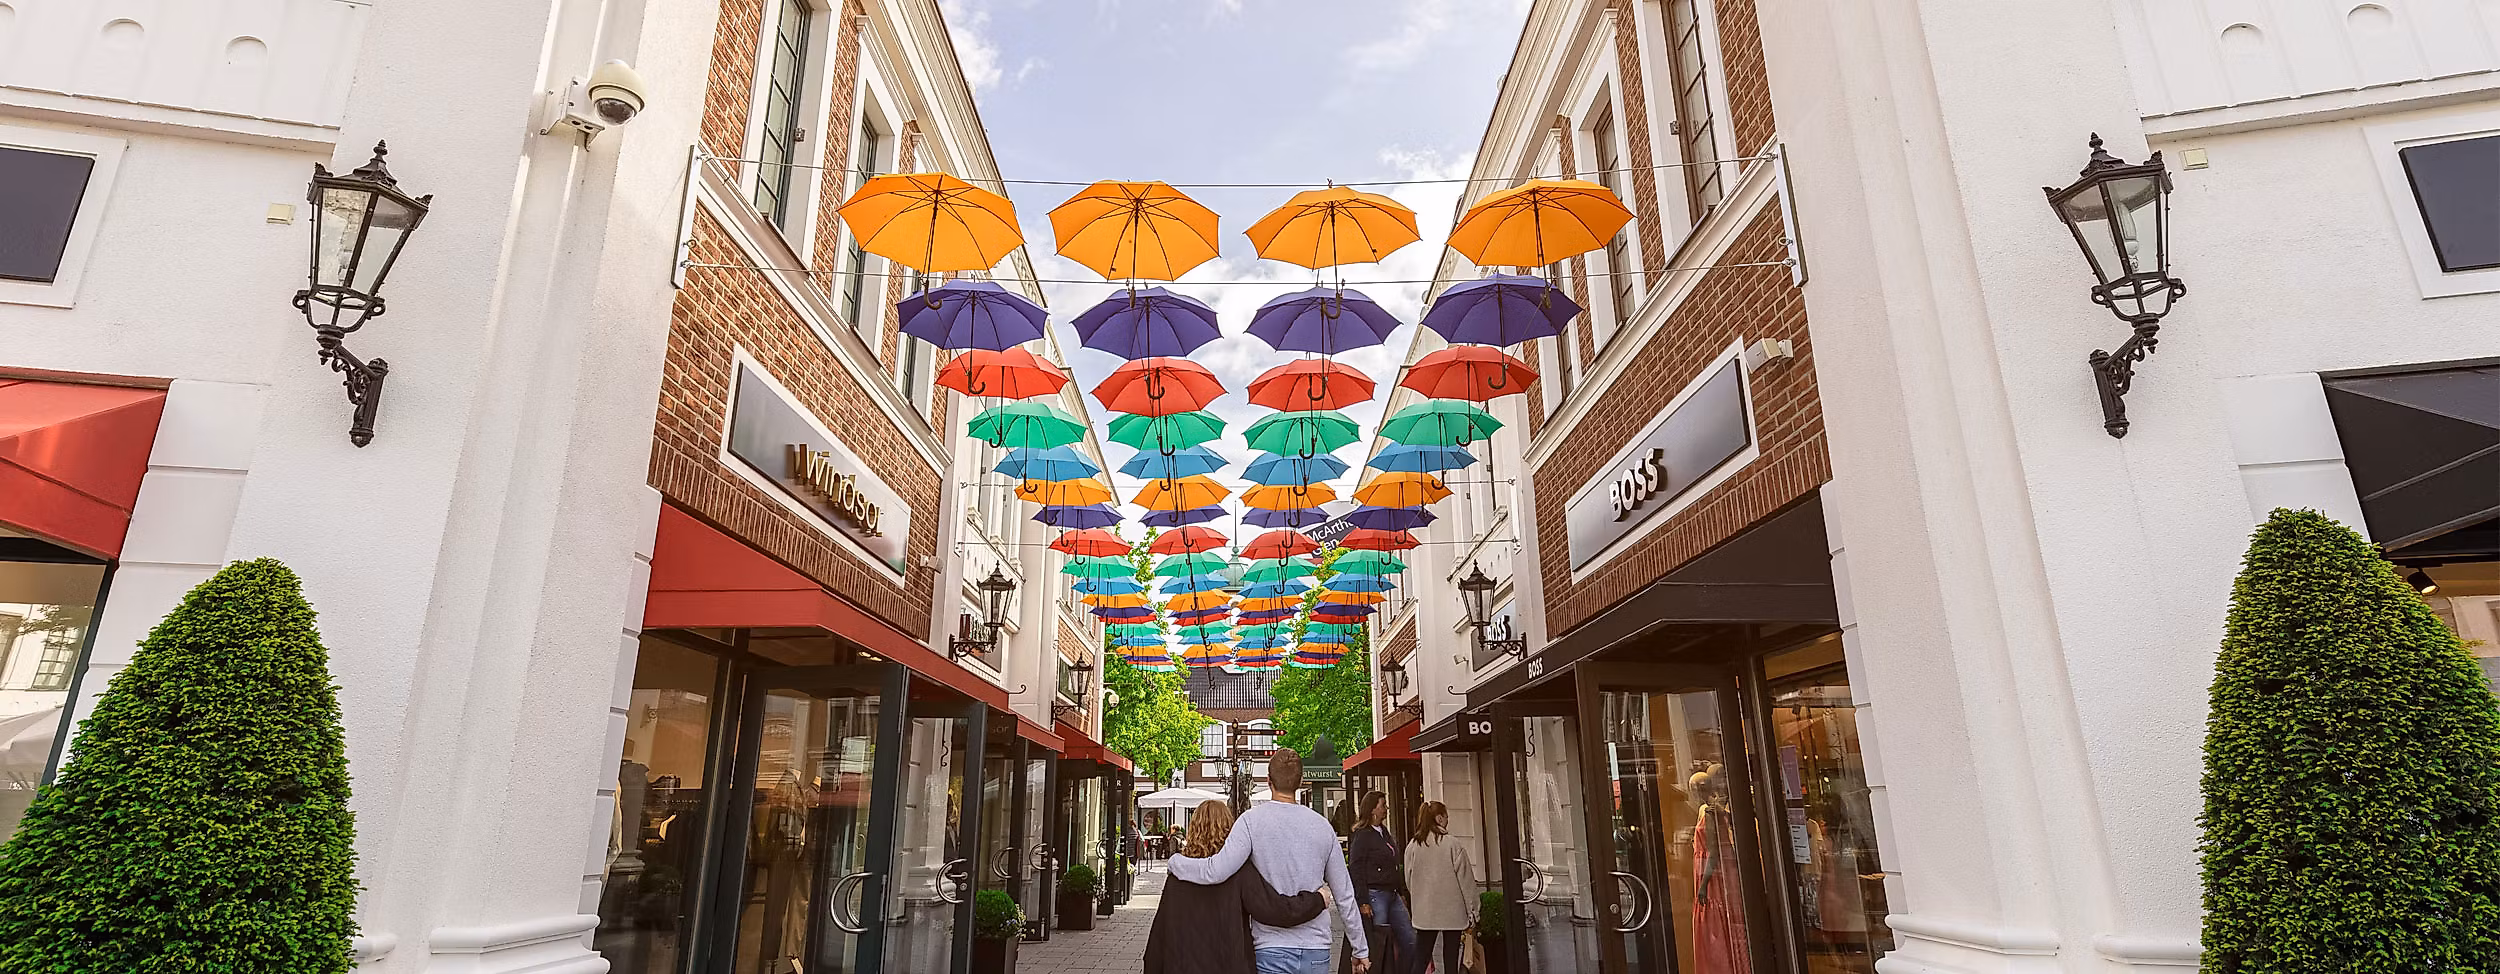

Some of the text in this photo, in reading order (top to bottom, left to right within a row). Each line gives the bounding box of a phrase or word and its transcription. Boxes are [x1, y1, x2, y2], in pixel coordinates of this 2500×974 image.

[1609, 447, 1661, 523] BOSS
[1306, 518, 1358, 541] McArth
[1528, 656, 1543, 679] BOSS
[1468, 720, 1492, 735] BO
[1303, 770, 1333, 778] atwurst
